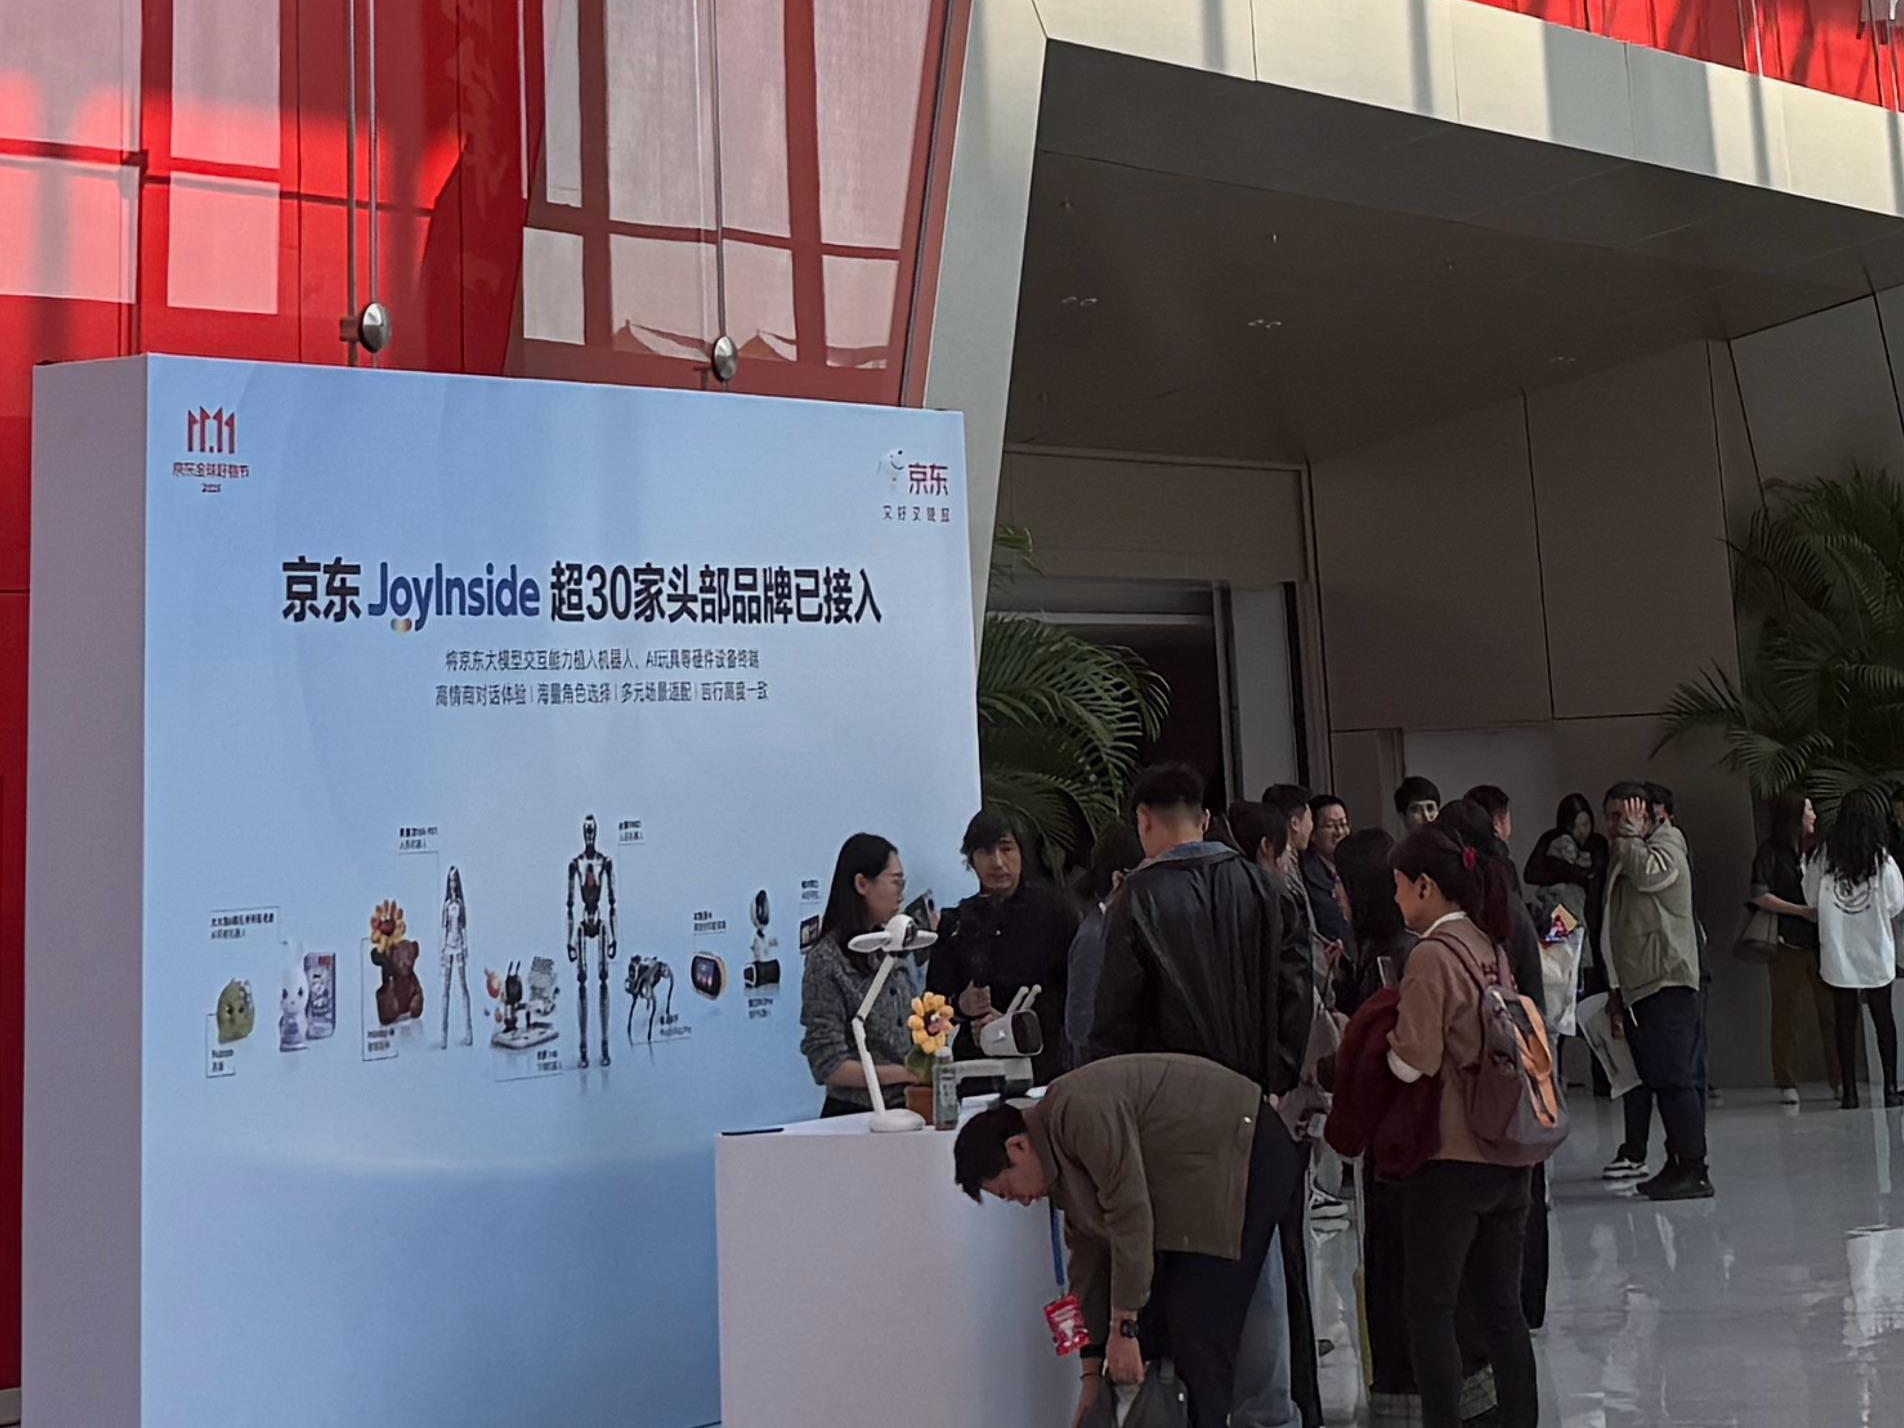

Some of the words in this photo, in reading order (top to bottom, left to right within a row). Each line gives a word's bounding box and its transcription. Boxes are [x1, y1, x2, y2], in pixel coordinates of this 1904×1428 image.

[908, 462, 949, 496] 京东
[281, 555, 362, 623] 京东
[368, 562, 540, 631] JoyInside
[550, 560, 883, 626] 超30家头部品牌已接入
